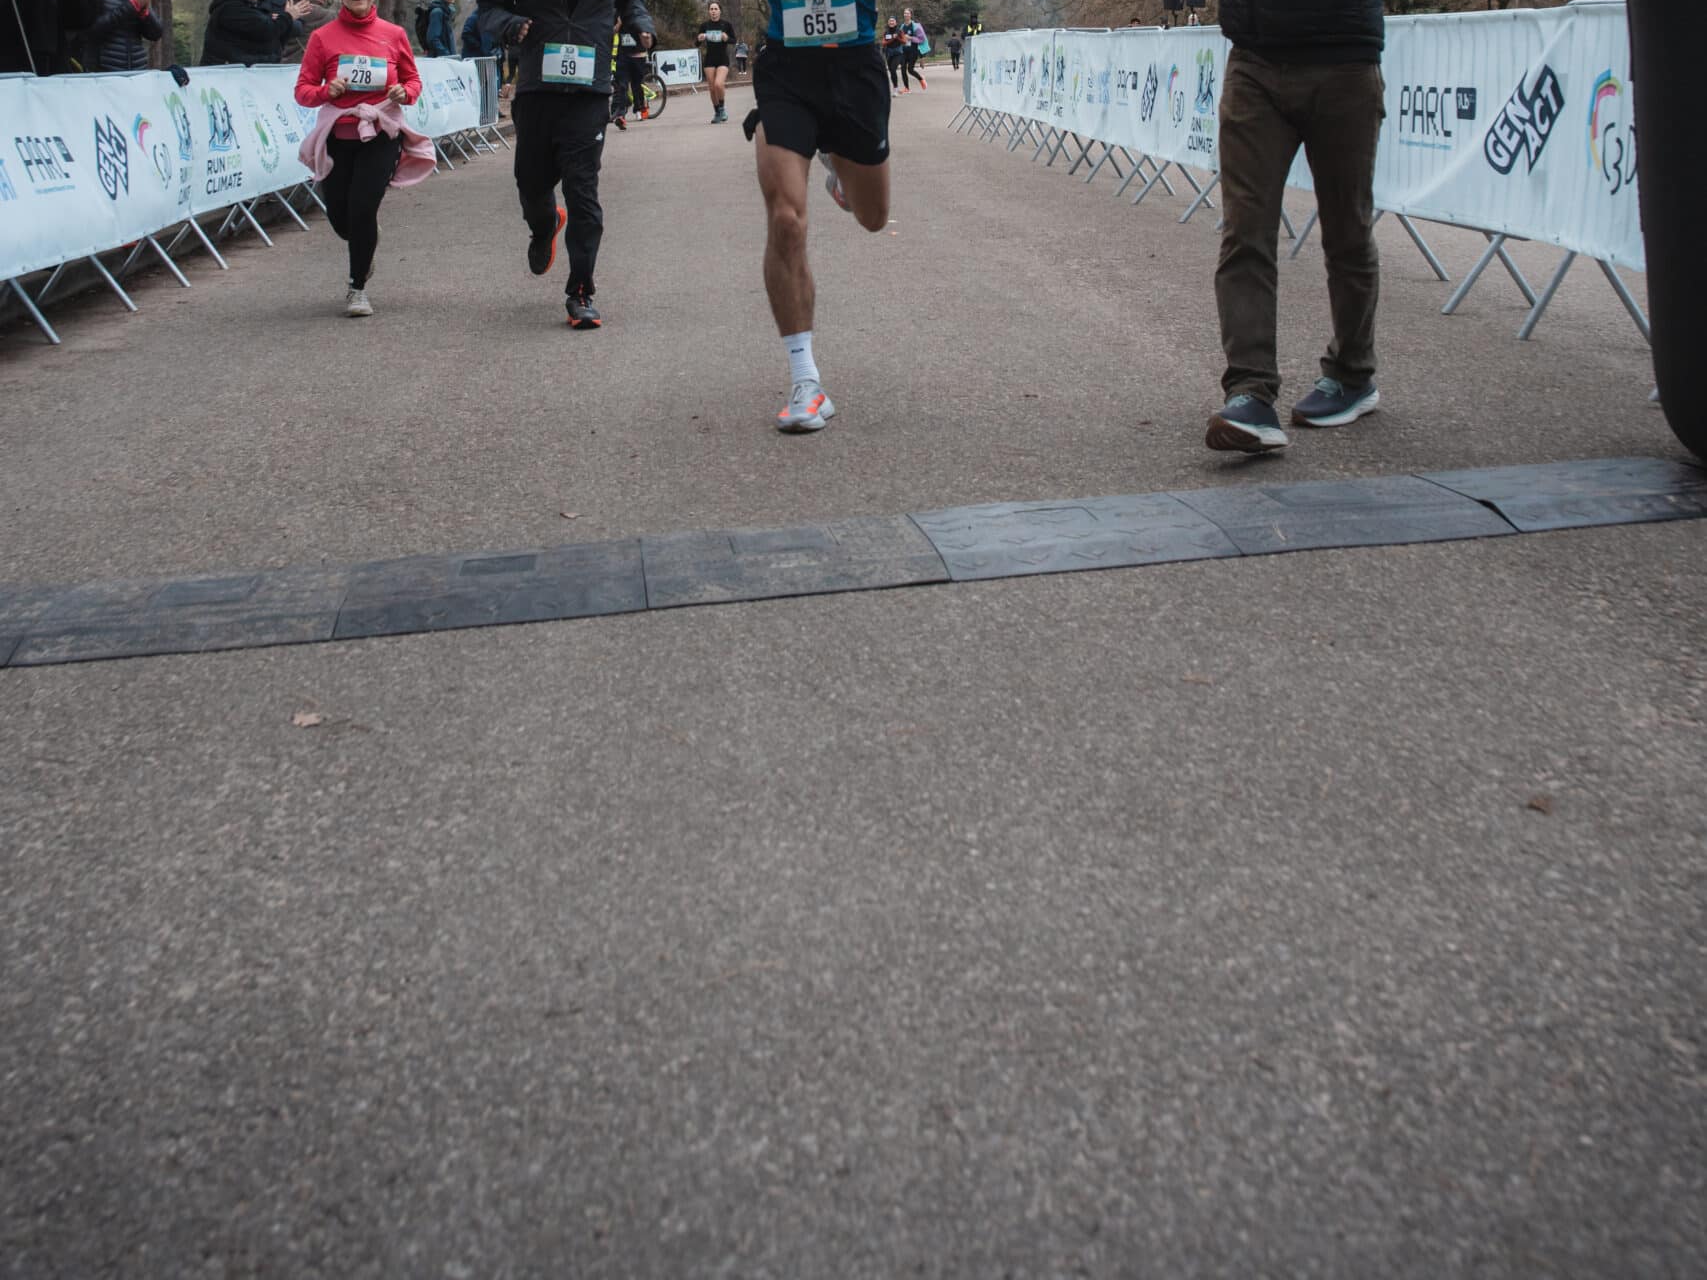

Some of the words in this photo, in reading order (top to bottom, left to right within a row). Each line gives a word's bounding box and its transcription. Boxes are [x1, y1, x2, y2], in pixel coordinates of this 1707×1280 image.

[803, 13, 838, 36] 655
[351, 69, 372, 84] 278
[560, 60, 576, 75] 59
[1400, 85, 1452, 137] PARC
[1523, 74, 1559, 165] ACT
[1486, 87, 1531, 168] GEN
[1187, 135, 1213, 154] CLIMATE
[14, 136, 70, 183] PARC
[207, 156, 226, 175] RUN
[206, 172, 243, 194] CLIMATE
